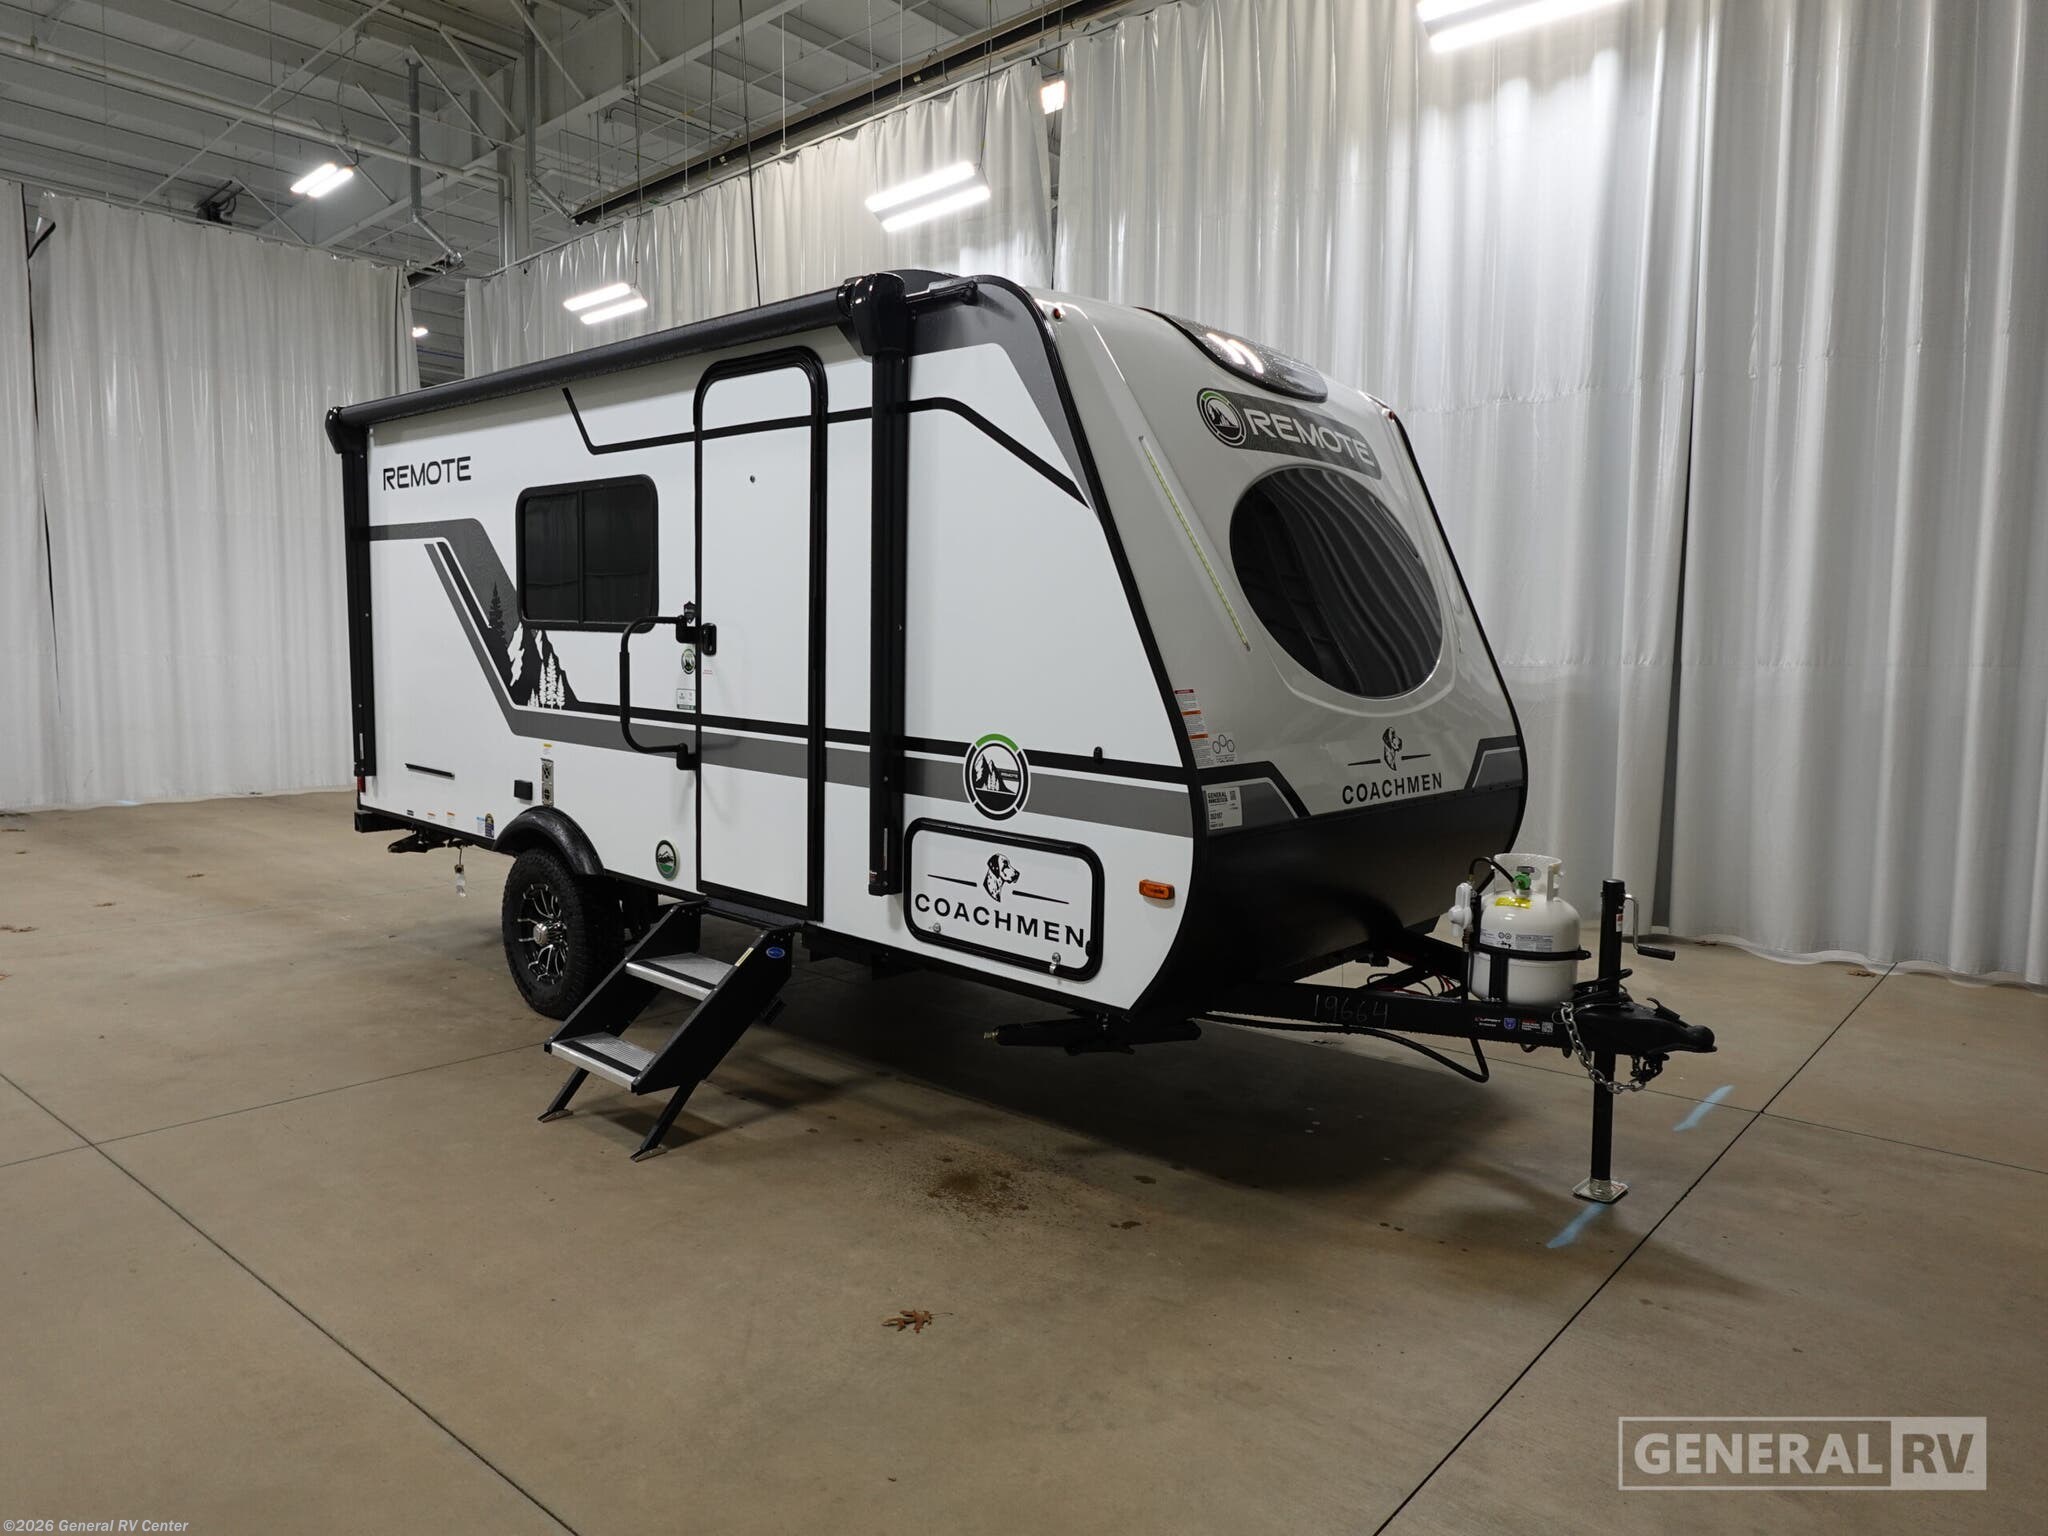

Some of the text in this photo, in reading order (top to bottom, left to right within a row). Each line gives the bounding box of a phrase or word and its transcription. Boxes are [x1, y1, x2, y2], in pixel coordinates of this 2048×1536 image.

[1243, 408, 1376, 467] REMOTE
[383, 456, 471, 491] REMOTE
[1342, 773, 1442, 804] COACHMEN
[915, 893, 1084, 948] COACHMEN
[1314, 993, 1388, 1027] 19664
